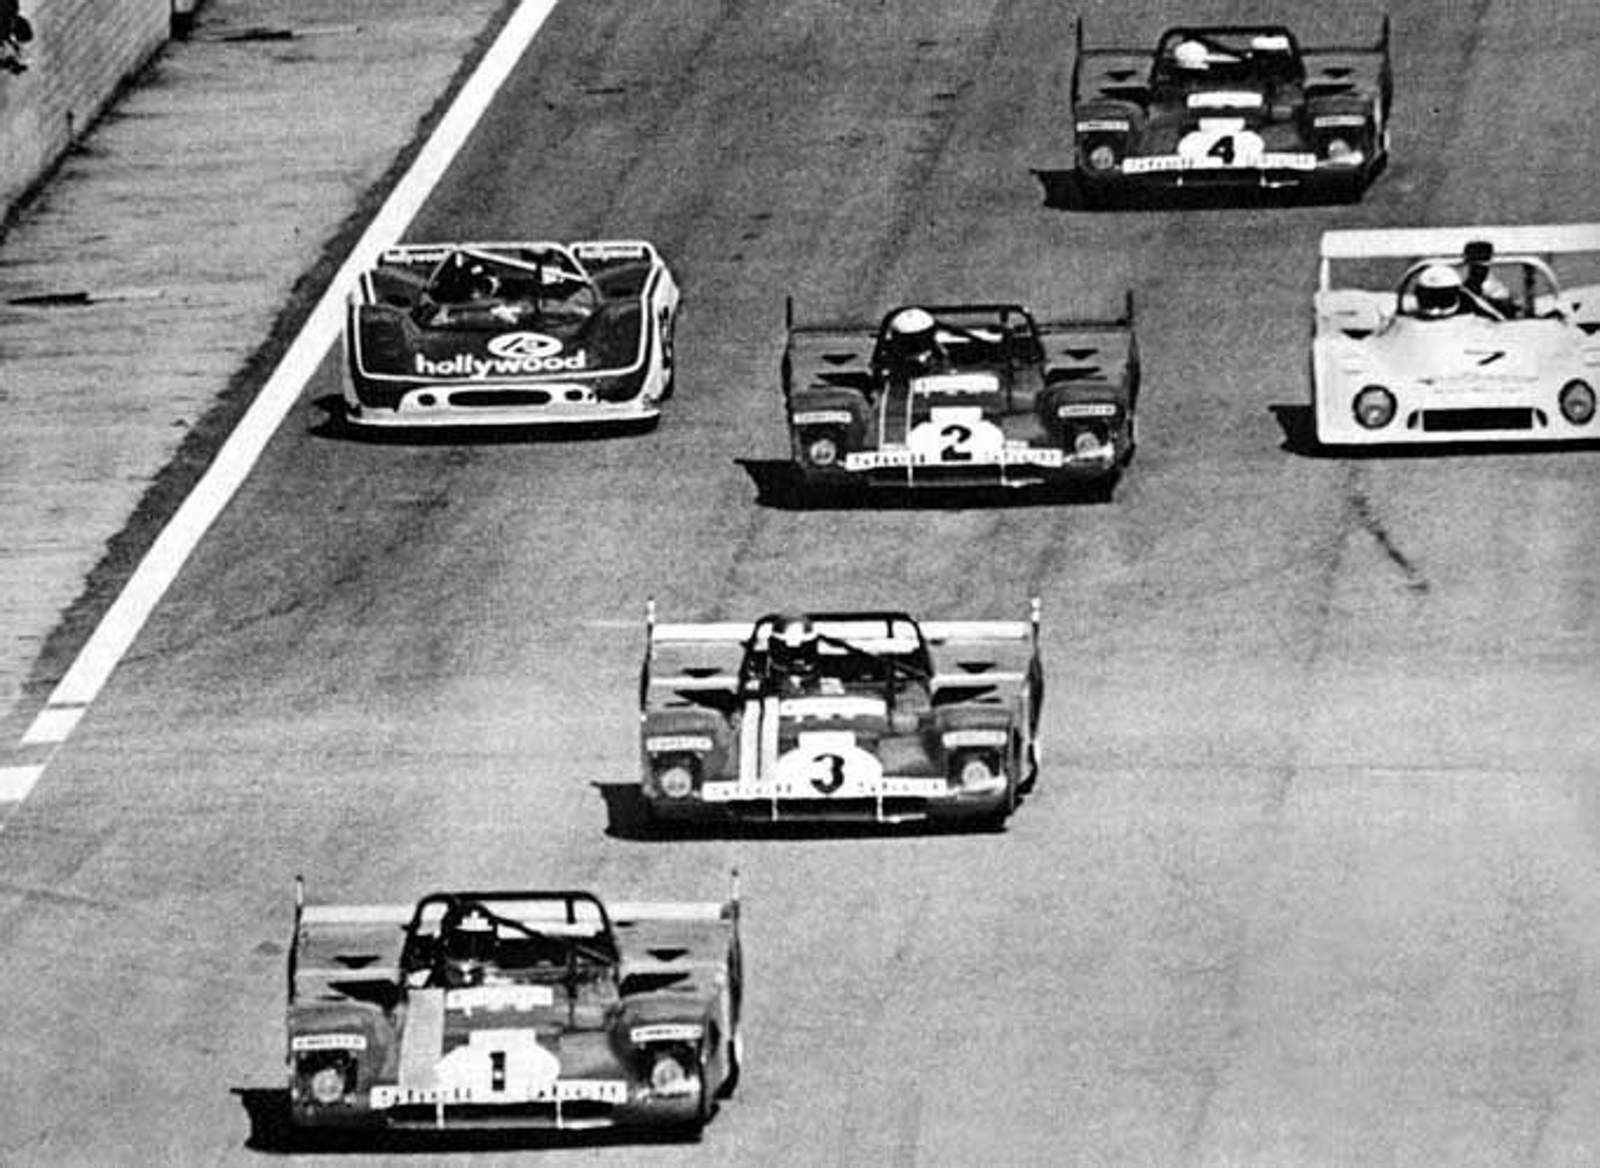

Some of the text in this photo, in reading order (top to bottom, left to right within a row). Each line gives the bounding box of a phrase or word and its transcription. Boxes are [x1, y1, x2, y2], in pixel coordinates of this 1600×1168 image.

[1207, 135, 1235, 164] 4
[415, 349, 586, 380] hollywood
[940, 424, 972, 462] 2
[811, 754, 845, 795] 3
[490, 1051, 506, 1092] 1
